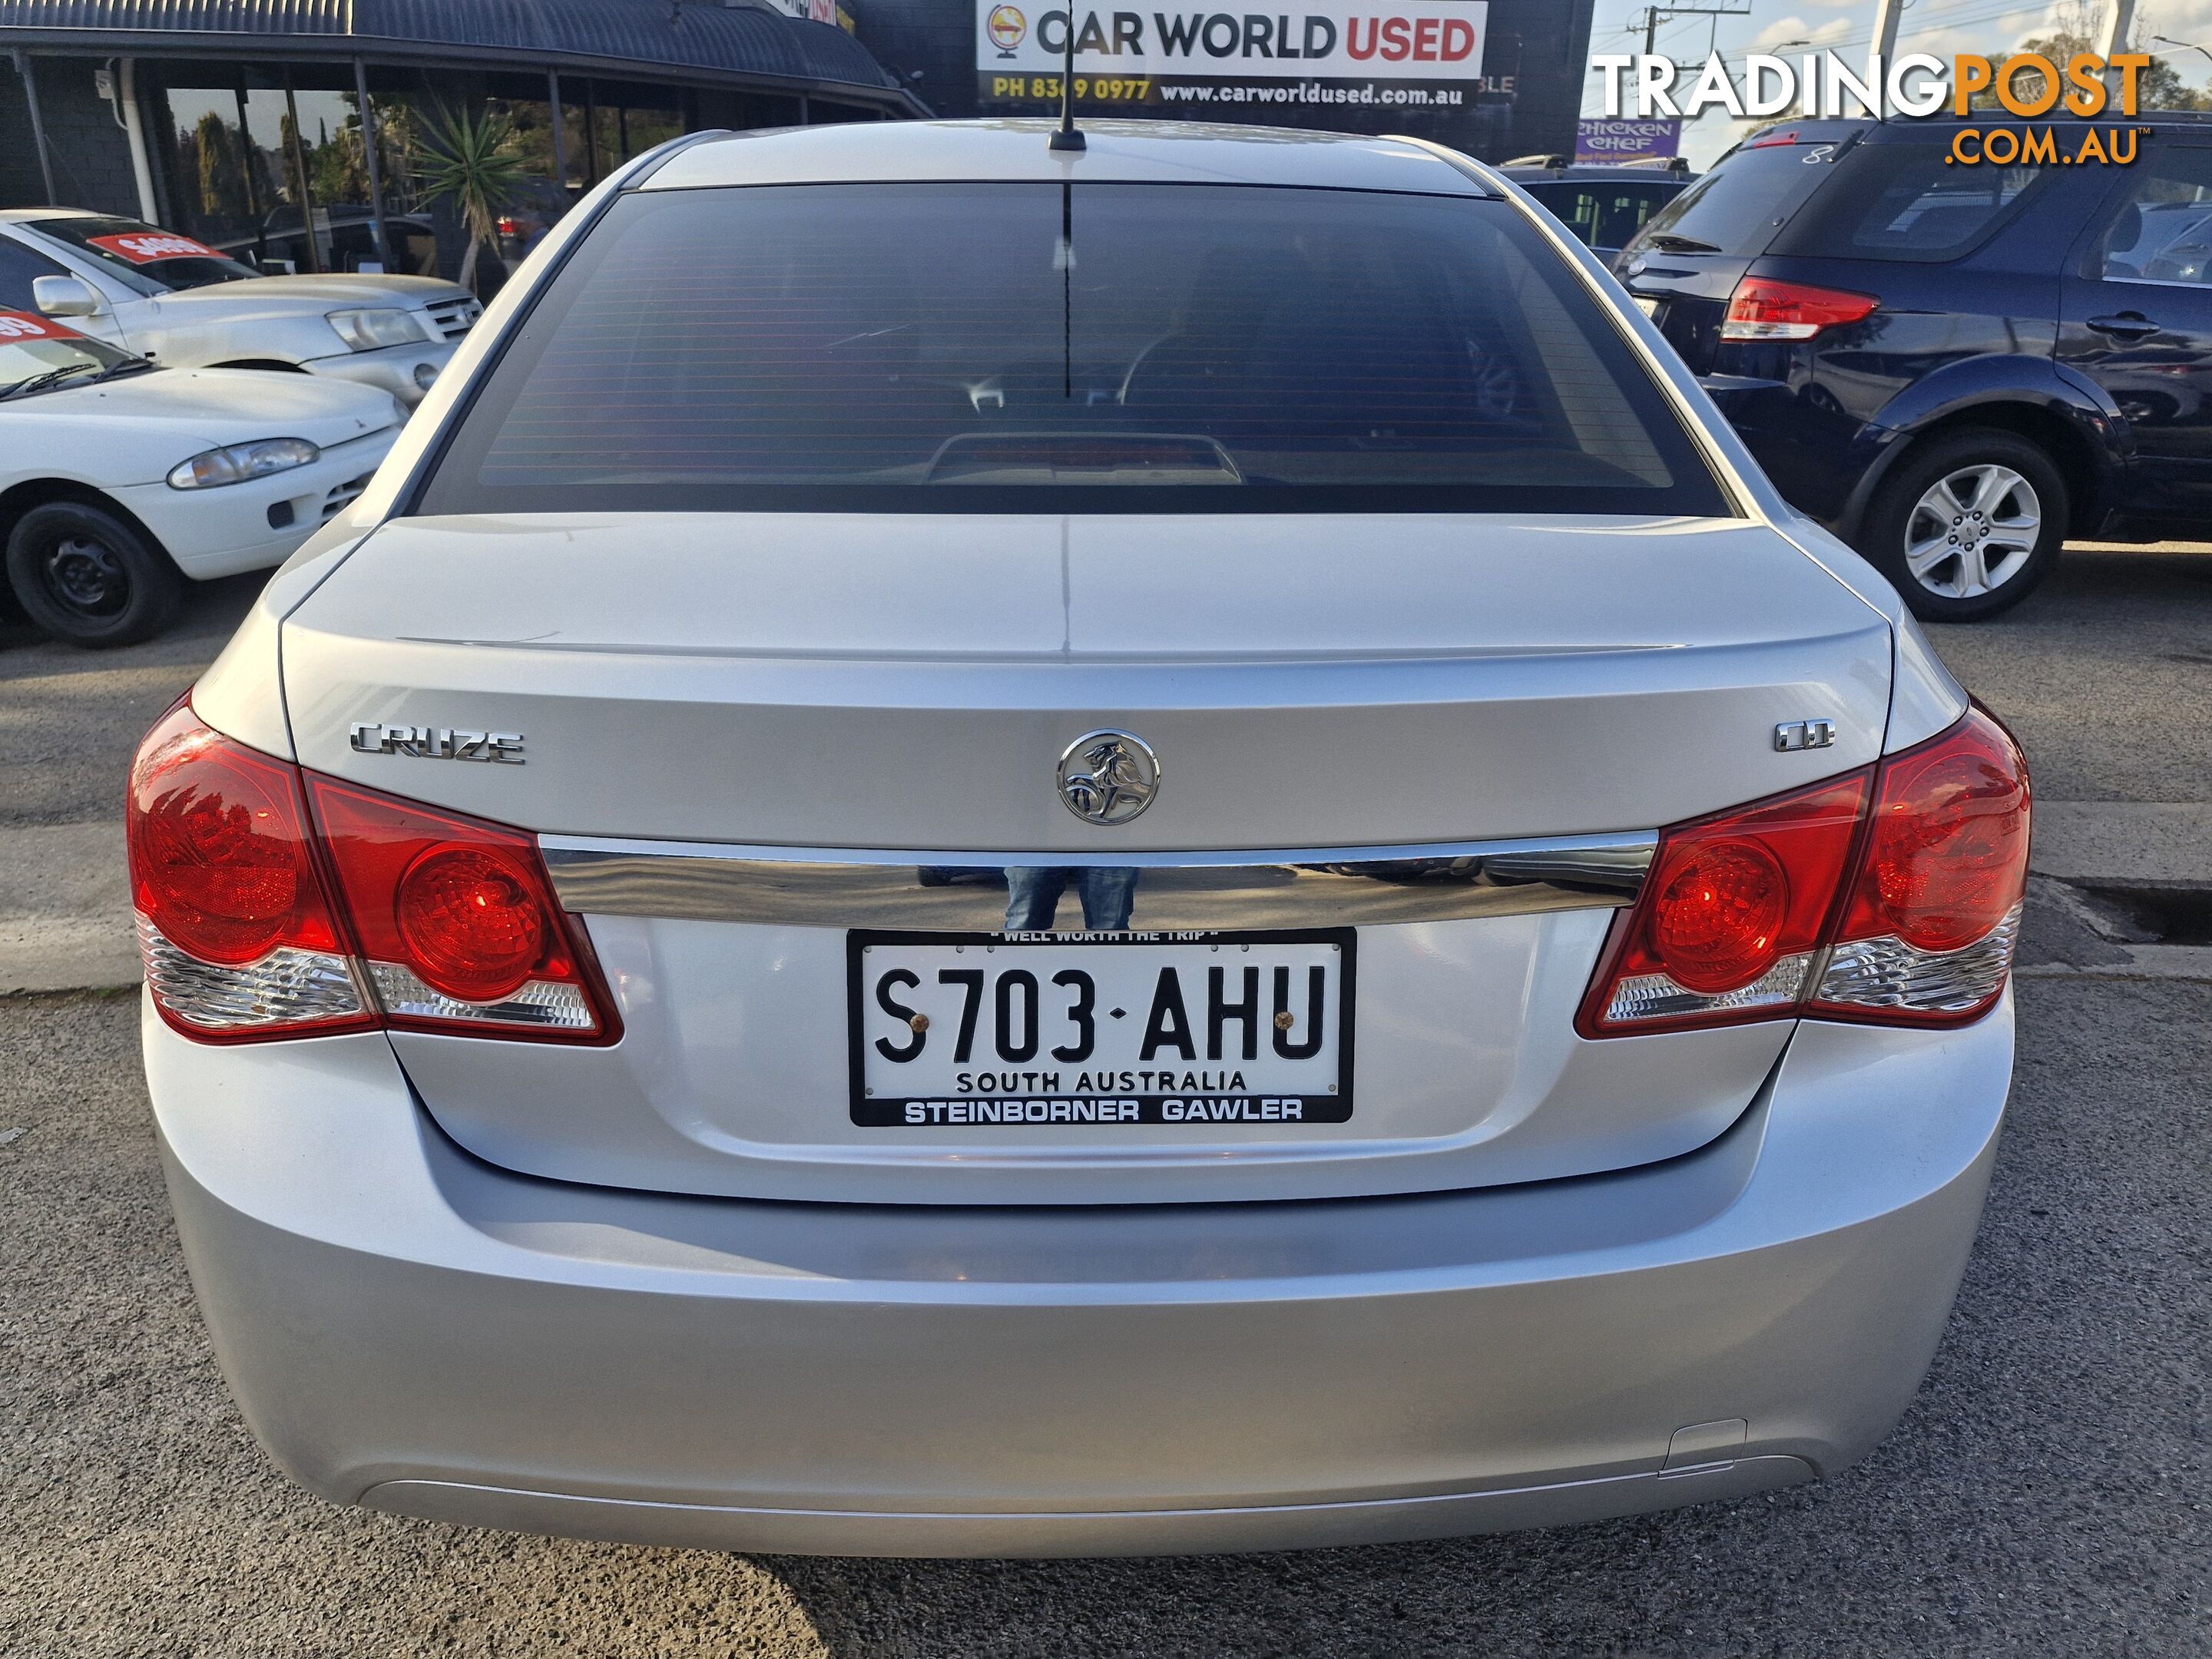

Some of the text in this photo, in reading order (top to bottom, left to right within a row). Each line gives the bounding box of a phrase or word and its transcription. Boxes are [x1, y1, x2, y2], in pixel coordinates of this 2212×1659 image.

[1038, 10, 1475, 61] CAR WORLD USED
[993, 77, 1025, 98] PH
[1094, 79, 1151, 99] 0977
[1160, 82, 1463, 105] www.carworldused.com.au
[350, 722, 525, 765] CRUZE
[1775, 719, 1836, 753] CD
[956, 1070, 1247, 1094] SOUTH AUSTRALIA
[905, 1098, 1303, 1123] STEINBORNER GAWLER
